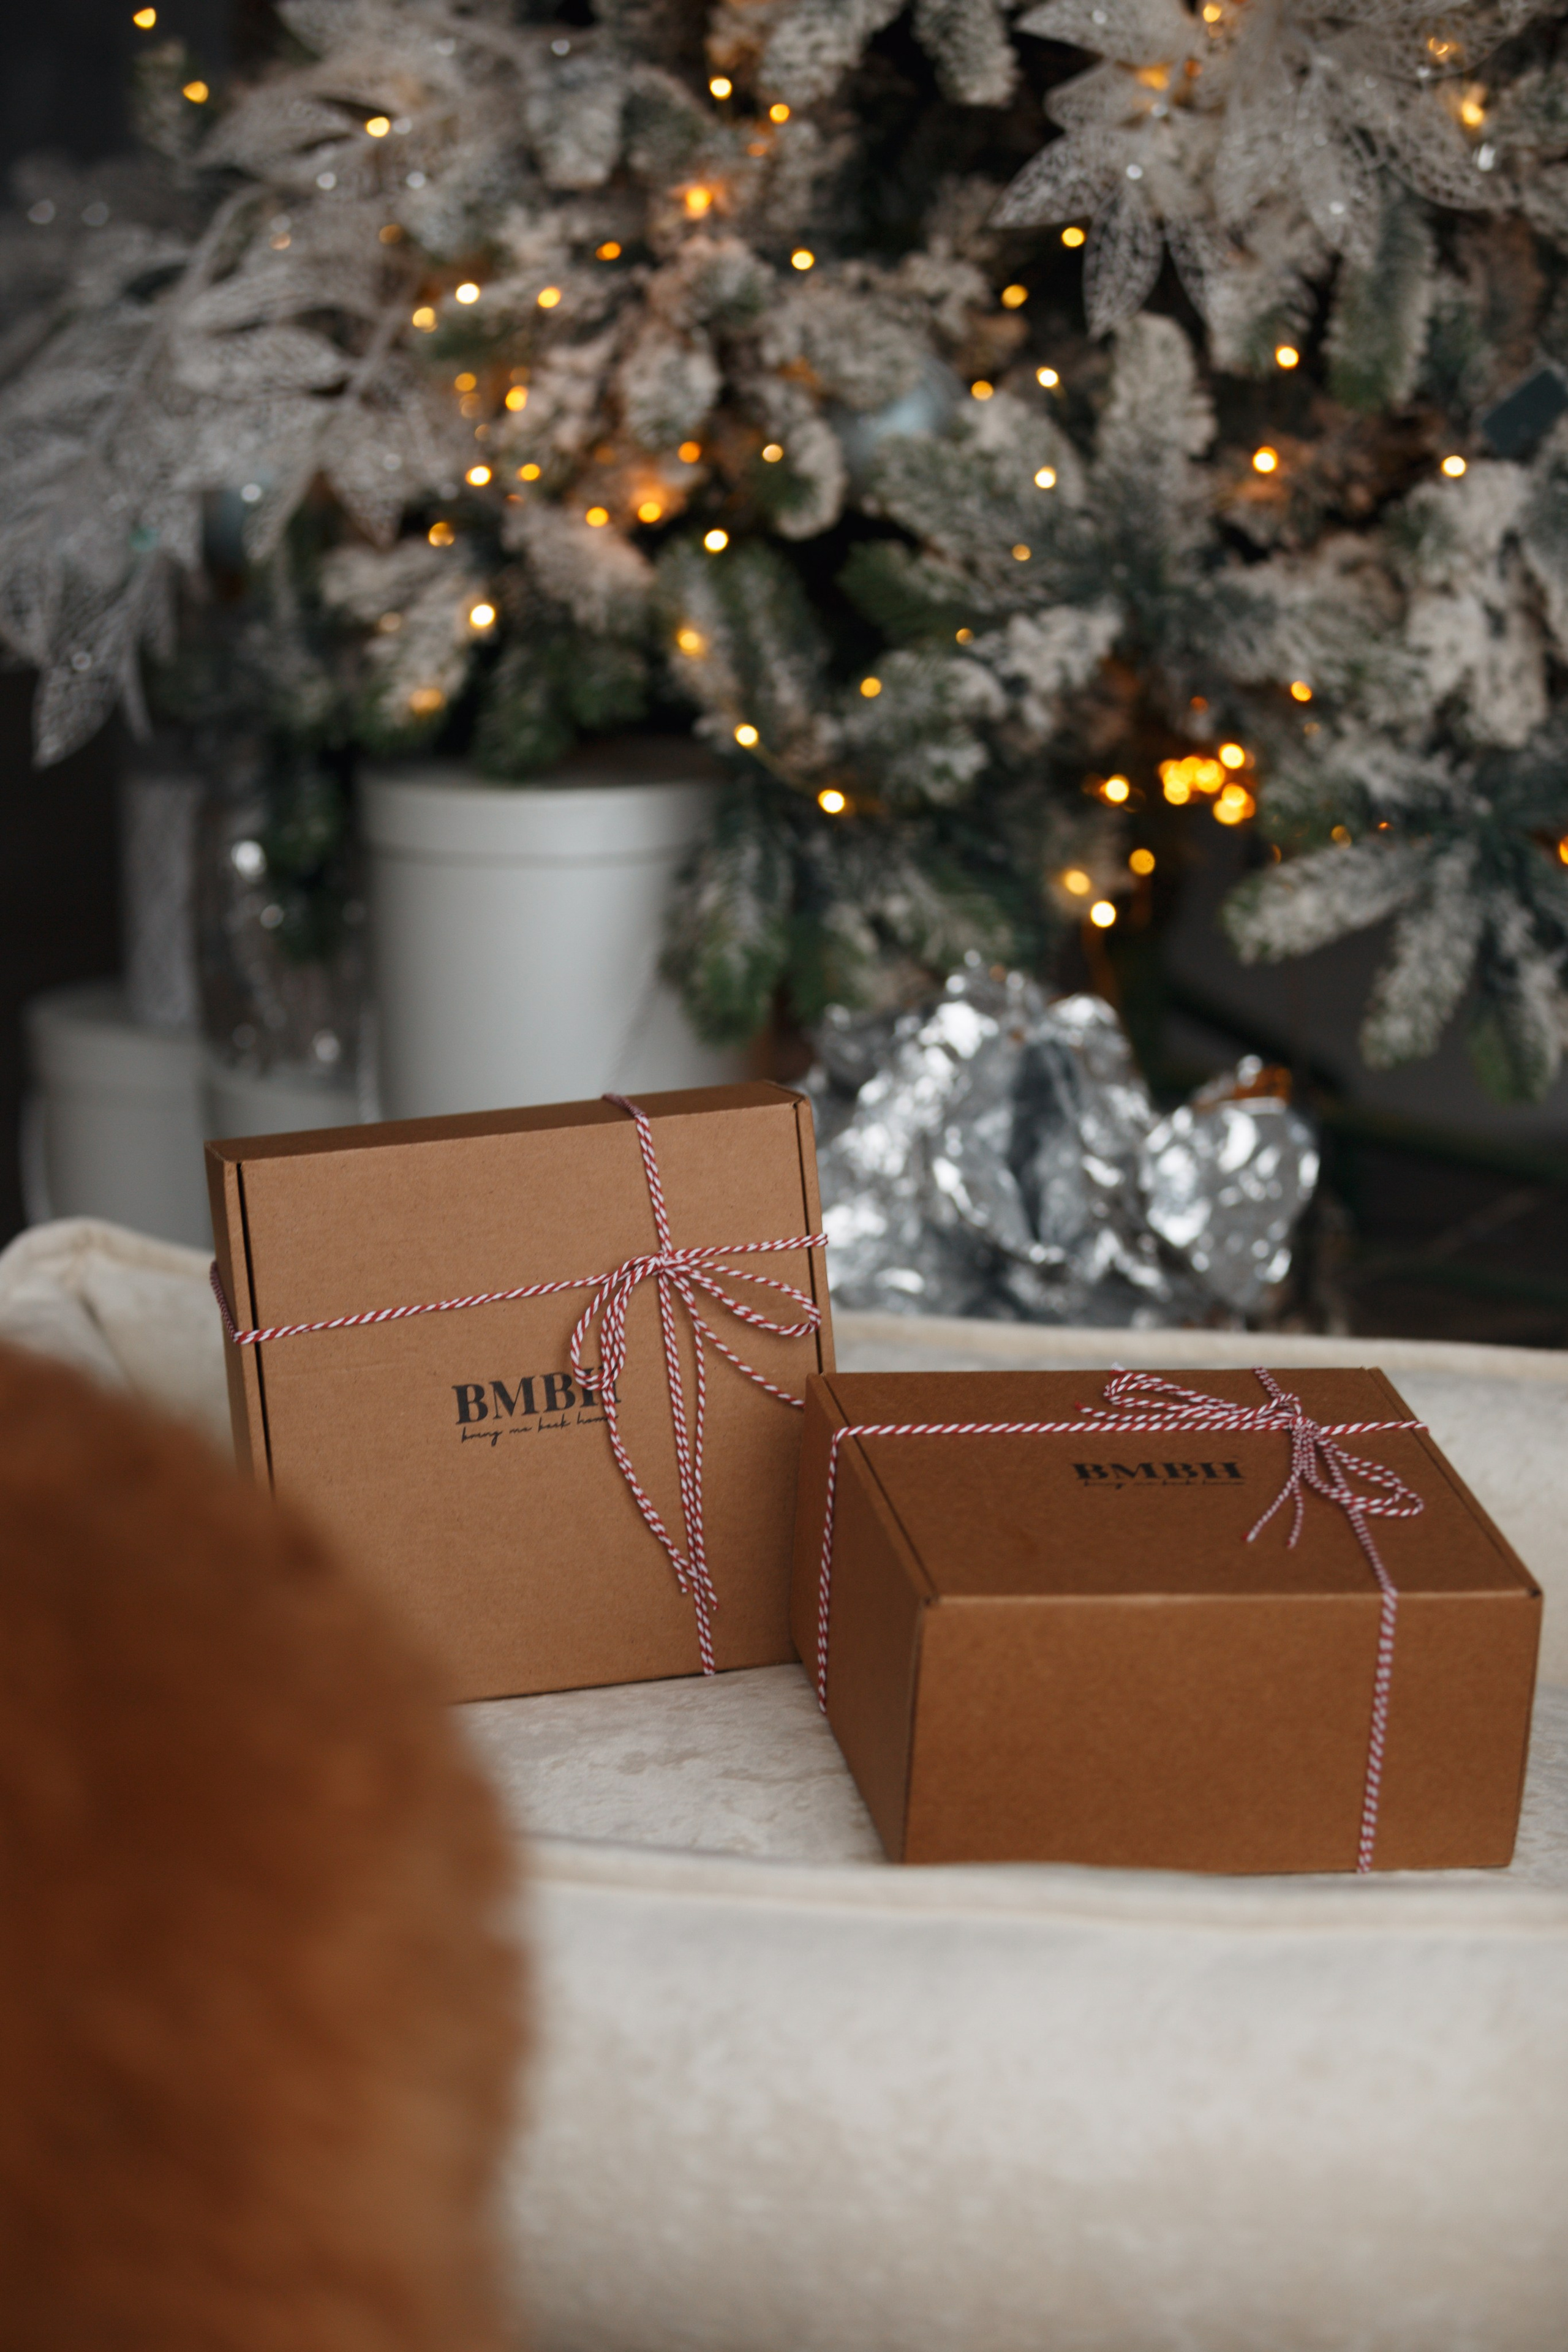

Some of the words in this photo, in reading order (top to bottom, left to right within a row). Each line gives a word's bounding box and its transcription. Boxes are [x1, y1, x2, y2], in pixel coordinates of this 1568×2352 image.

[461, 1427, 502, 1447] bring
[538, 1414, 571, 1433] back
[577, 1411, 619, 1425] hom
[1071, 1461, 1246, 1479] BMBH
